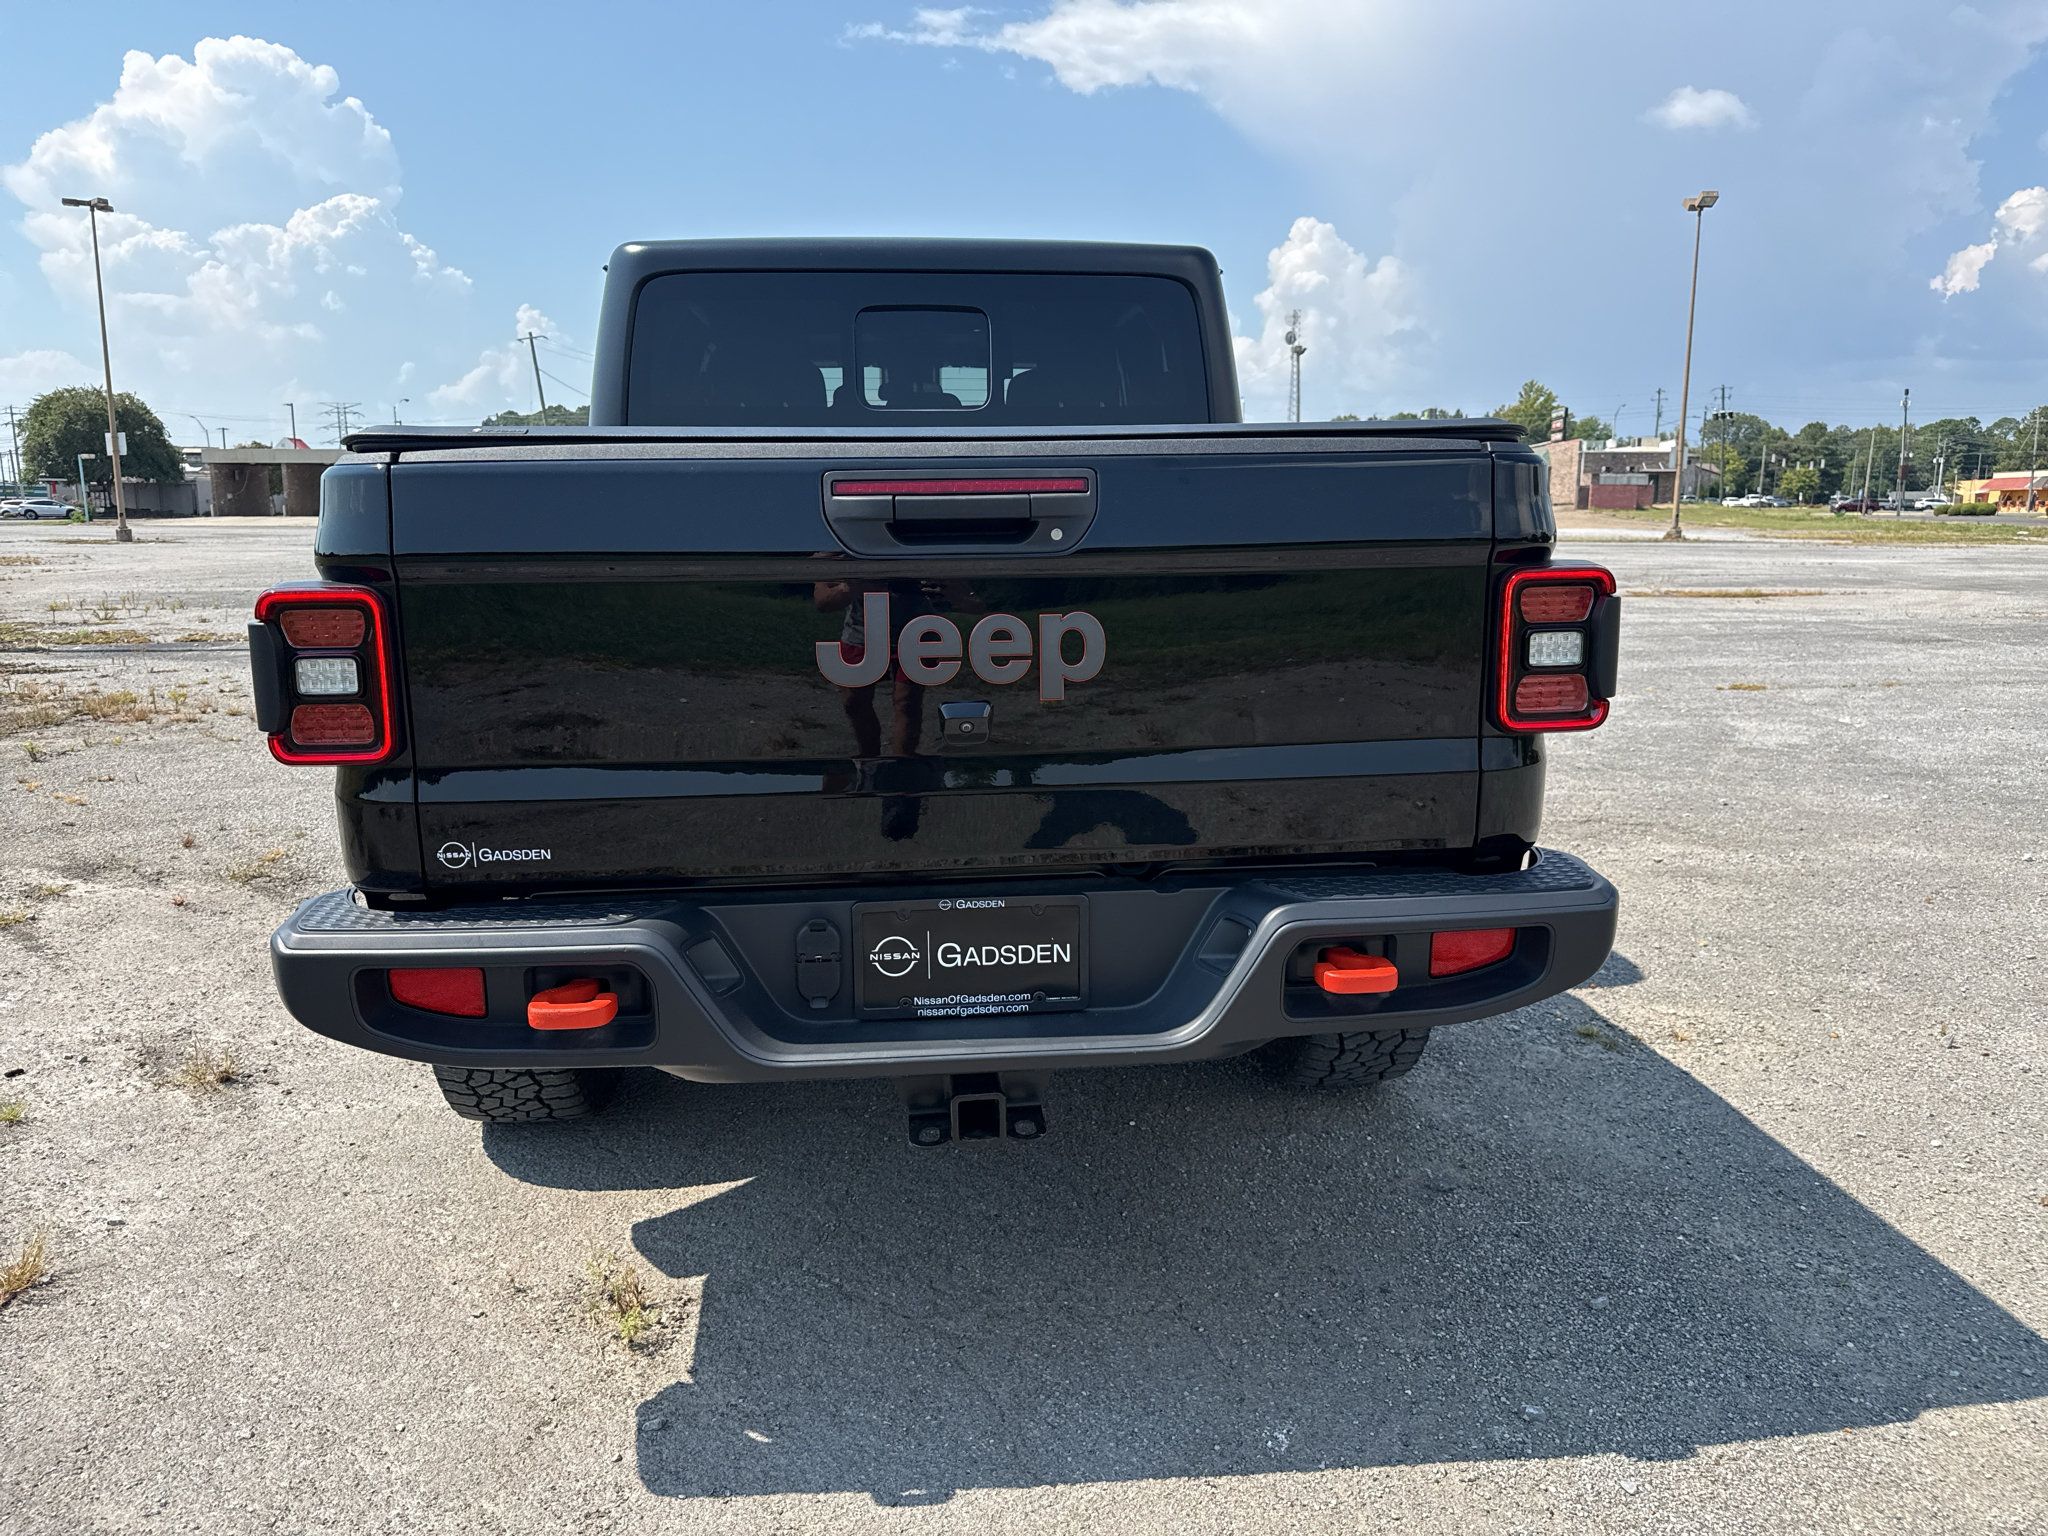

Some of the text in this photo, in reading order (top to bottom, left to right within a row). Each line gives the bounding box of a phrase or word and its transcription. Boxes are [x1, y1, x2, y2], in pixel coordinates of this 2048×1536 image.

[815, 591, 1107, 702] Jeep
[479, 848, 551, 862] GADSDEN
[956, 899, 1005, 909] GADSDEN
[870, 942, 1071, 967] NISSAN GADSDEN
[914, 993, 1031, 1006] NissanOfGadsden.com
[918, 1003, 1029, 1017] nissanofgadsden.com
